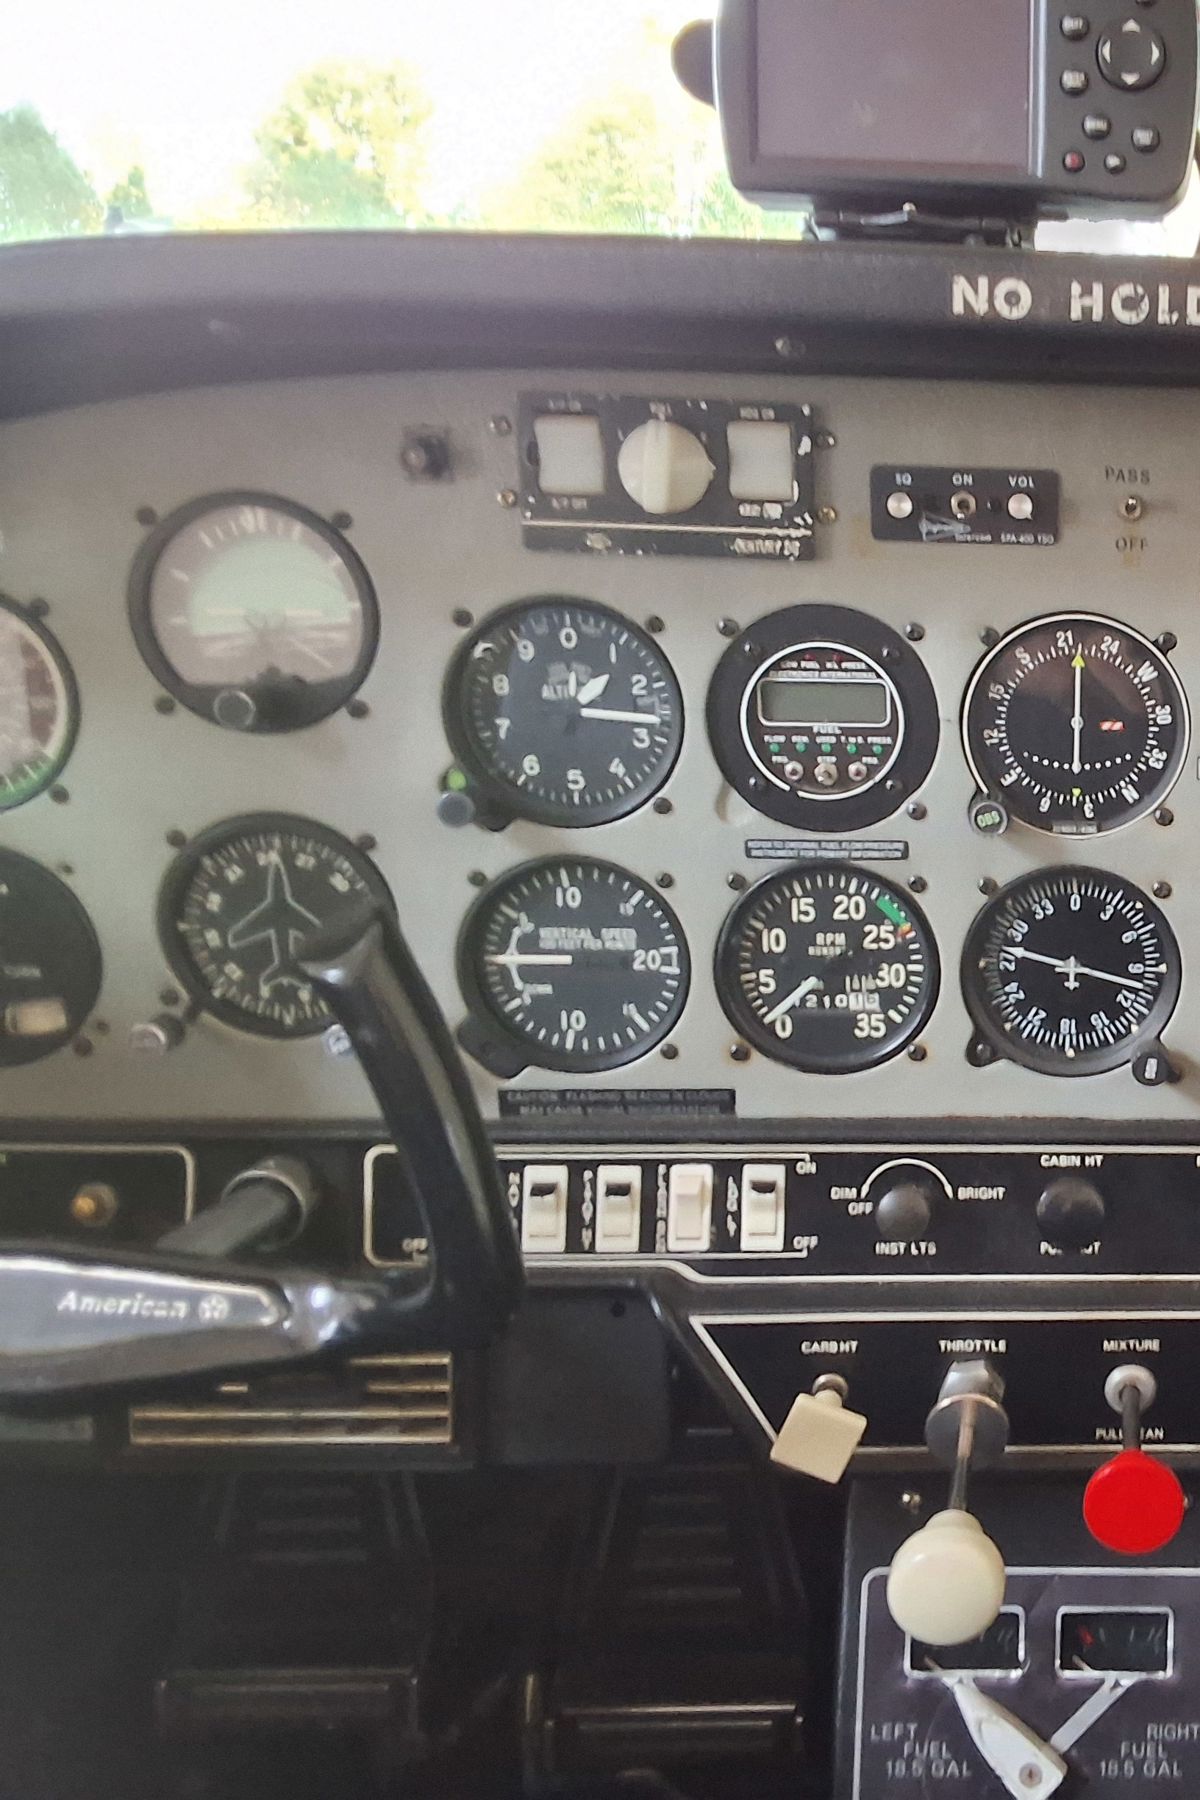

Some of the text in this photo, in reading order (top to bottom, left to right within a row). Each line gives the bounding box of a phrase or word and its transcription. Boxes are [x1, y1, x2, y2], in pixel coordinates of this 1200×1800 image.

[952, 274, 1032, 320] NO
[952, 473, 973, 486] ON
[1008, 475, 1034, 488] VOL
[560, 627, 577, 649] 0
[1056, 630, 1074, 647] 21
[1101, 635, 1121, 655] 24
[517, 639, 535, 662] 9
[1015, 647, 1031, 665] S
[1137, 660, 1158, 683] W
[493, 674, 509, 696] 8
[631, 674, 647, 696] 2
[989, 683, 1005, 701] 15
[1155, 705, 1172, 725] 30
[495, 718, 511, 739] 7
[633, 728, 650, 748] 3
[983, 729, 999, 747] 12
[523, 755, 540, 776] 6
[609, 758, 626, 778] 4
[1149, 748, 1168, 770] 33
[567, 769, 585, 791] 5
[1000, 768, 1019, 787] E
[1121, 784, 1140, 805] N
[556, 886, 582, 909] 10
[833, 895, 866, 920] 20
[1070, 894, 1080, 911] 0
[791, 897, 816, 923] 15
[1031, 899, 1054, 920] 33
[1100, 905, 1114, 921] 3
[815, 932, 846, 946] RPM
[863, 925, 896, 950] 25
[1007, 919, 1029, 942] 30
[1121, 930, 1138, 944] 6
[762, 928, 787, 954] 10
[633, 949, 661, 972] 20
[758, 968, 776, 994] 5
[876, 963, 906, 988] 30
[1004, 982, 1025, 1003] 24
[1116, 989, 1136, 1008] 12
[561, 1010, 587, 1031] 10
[775, 1014, 793, 1039] 0
[854, 1013, 887, 1038] 35
[796, 1161, 816, 1174] ON
[1040, 1155, 1103, 1167] CABIN HT
[831, 1187, 857, 1199] DIM
[958, 1187, 1006, 1200] BRIGHT
[848, 1202, 873, 1215] OFF
[793, 1235, 818, 1249] OFF
[875, 1242, 906, 1255] INST
[57, 1291, 190, 1320] American
[801, 1340, 858, 1354] CARB HT
[939, 1339, 1006, 1353] THROTTLE
[1103, 1339, 1160, 1352] MIXTURE
[871, 1723, 918, 1741] LEFT
[1147, 1723, 1200, 1741] RIGHT
[904, 1741, 950, 1760] FUEL
[1121, 1741, 1168, 1760] FUEL
[931, 1760, 972, 1778] GAL
[1143, 1760, 1182, 1778] GAL
